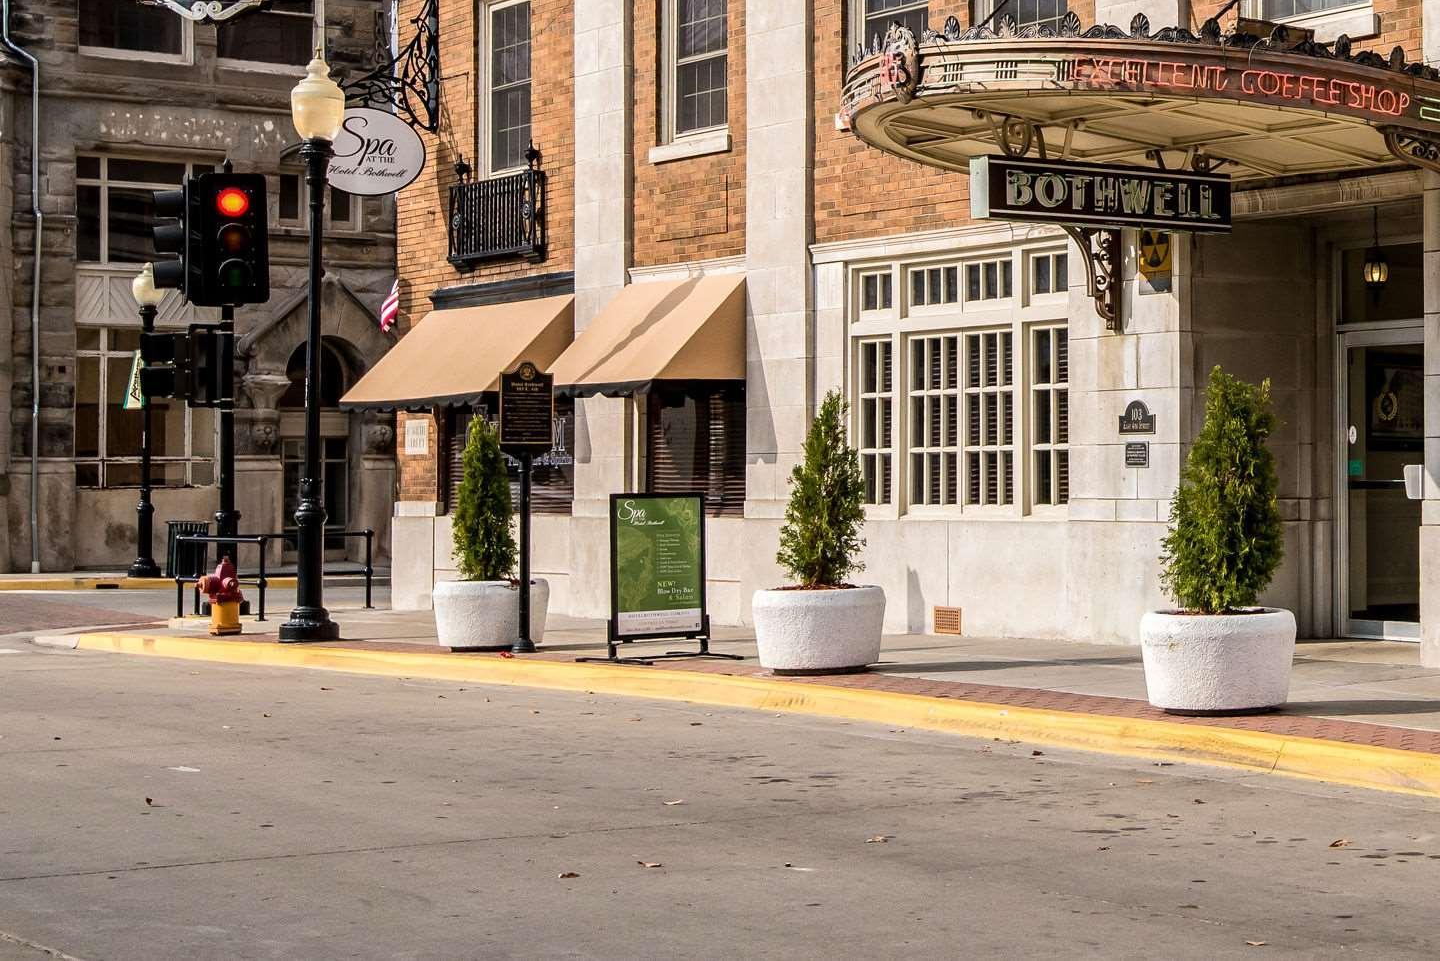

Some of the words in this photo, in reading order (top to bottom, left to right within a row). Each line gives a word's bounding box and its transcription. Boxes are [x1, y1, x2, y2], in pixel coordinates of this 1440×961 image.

[1068, 57, 1229, 89] EXCELLENT
[1242, 69, 1341, 105] COFFEE
[1347, 82, 1411, 115] SHOP
[333, 116, 398, 166] Spa
[328, 165, 357, 175] Hotel
[359, 166, 408, 177] Bothwell
[378, 156, 395, 164] THE
[1006, 169, 1221, 219] BOTHWELL
[1131, 408, 1143, 421] 103
[617, 500, 647, 523] Spa
